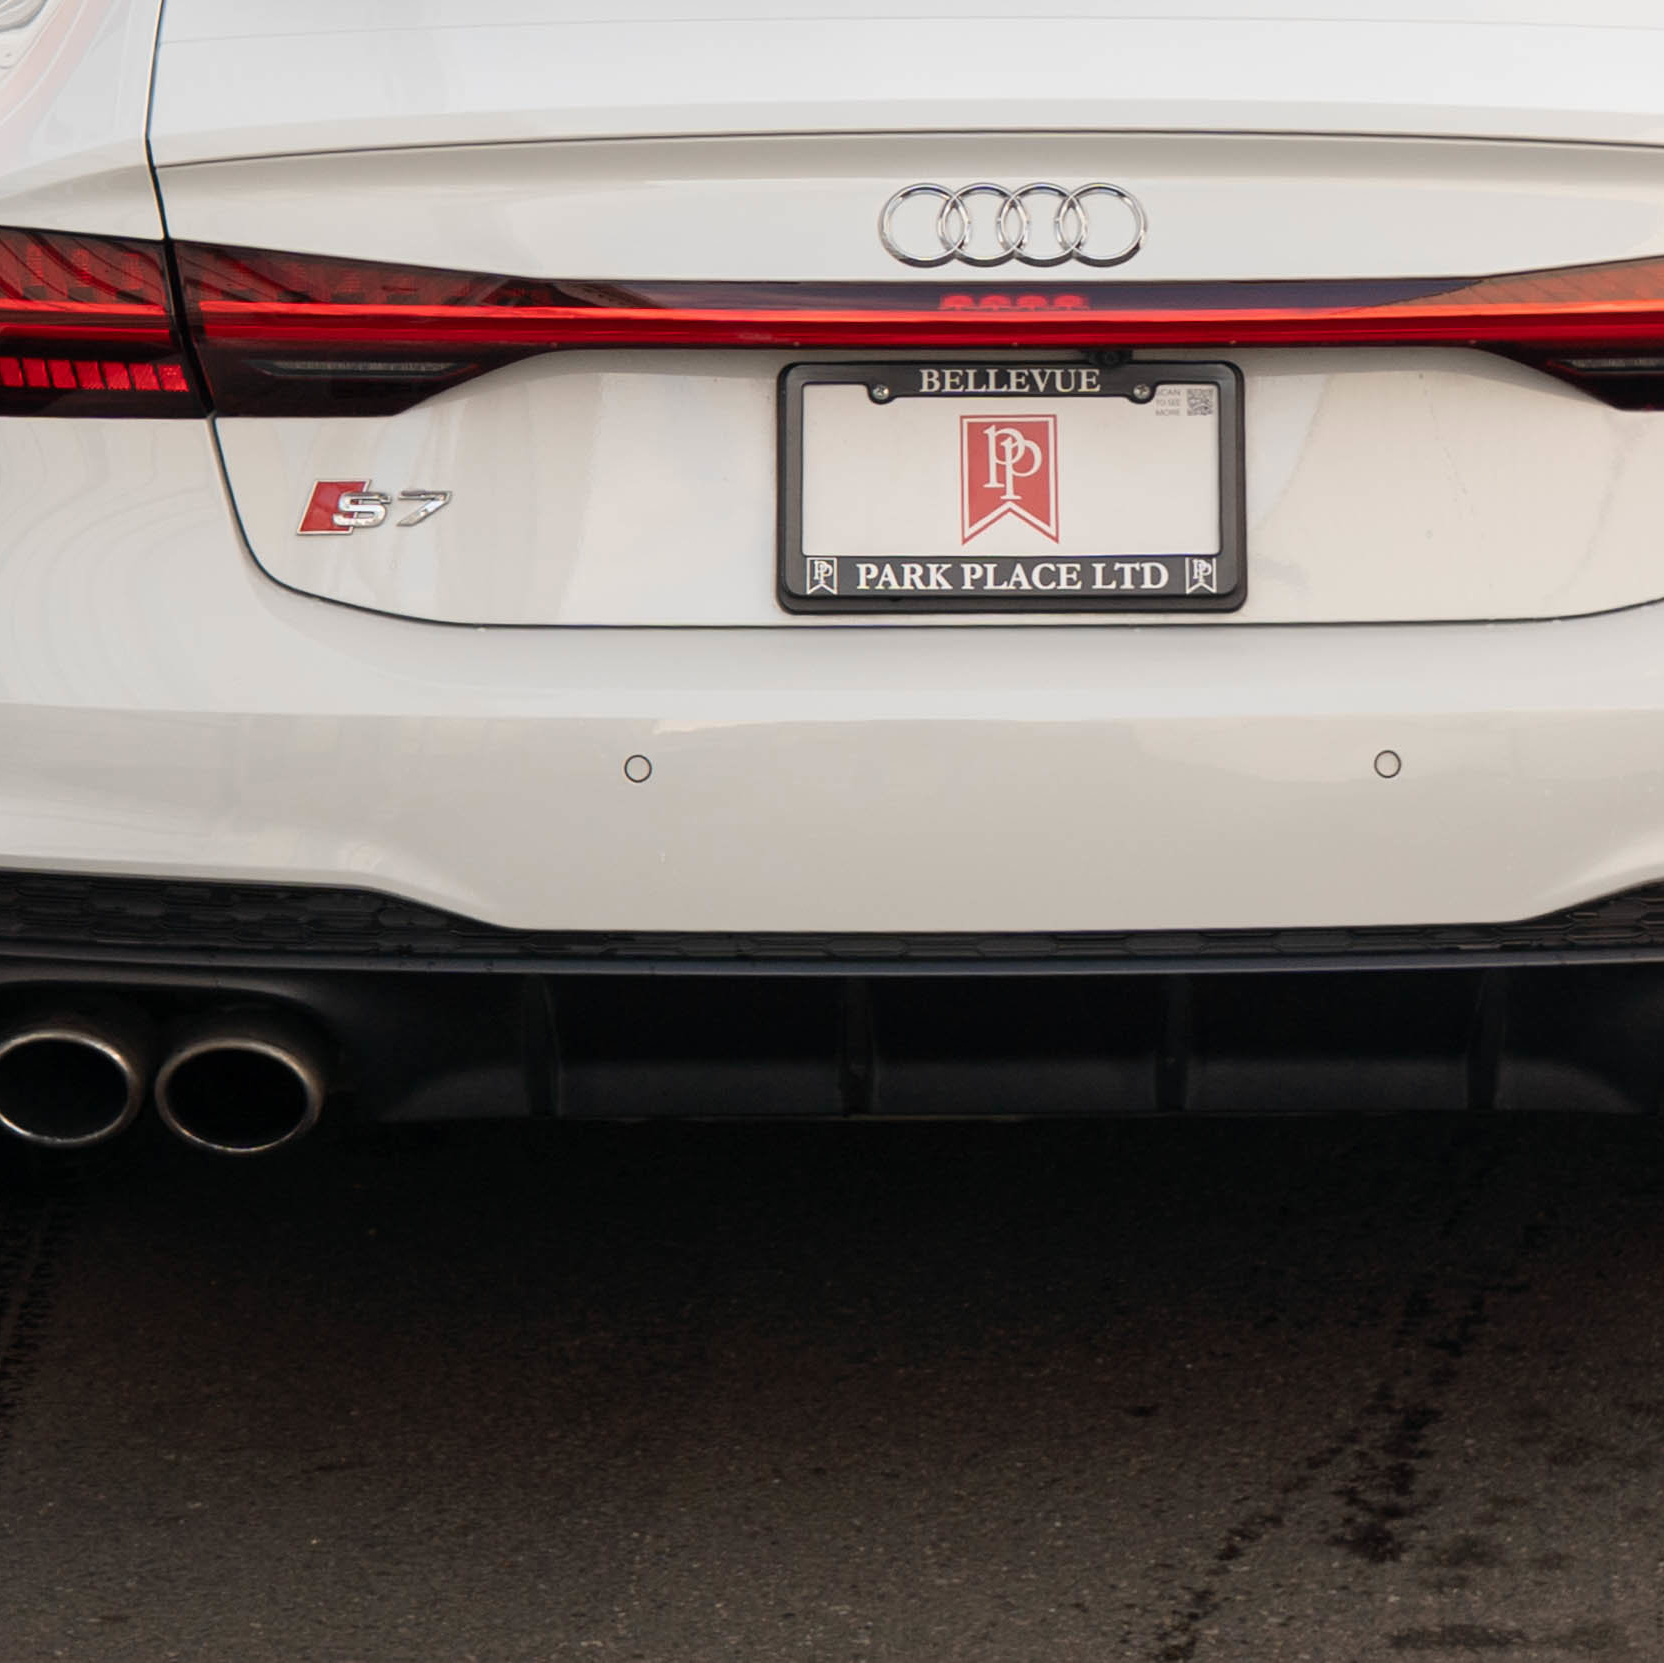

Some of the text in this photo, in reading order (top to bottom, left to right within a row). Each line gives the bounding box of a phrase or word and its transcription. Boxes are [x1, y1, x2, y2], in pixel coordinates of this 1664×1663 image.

[919, 368, 1101, 393] BELLEVUE
[331, 489, 453, 529] S7
[855, 561, 1170, 590] PARK PLACE LTD
